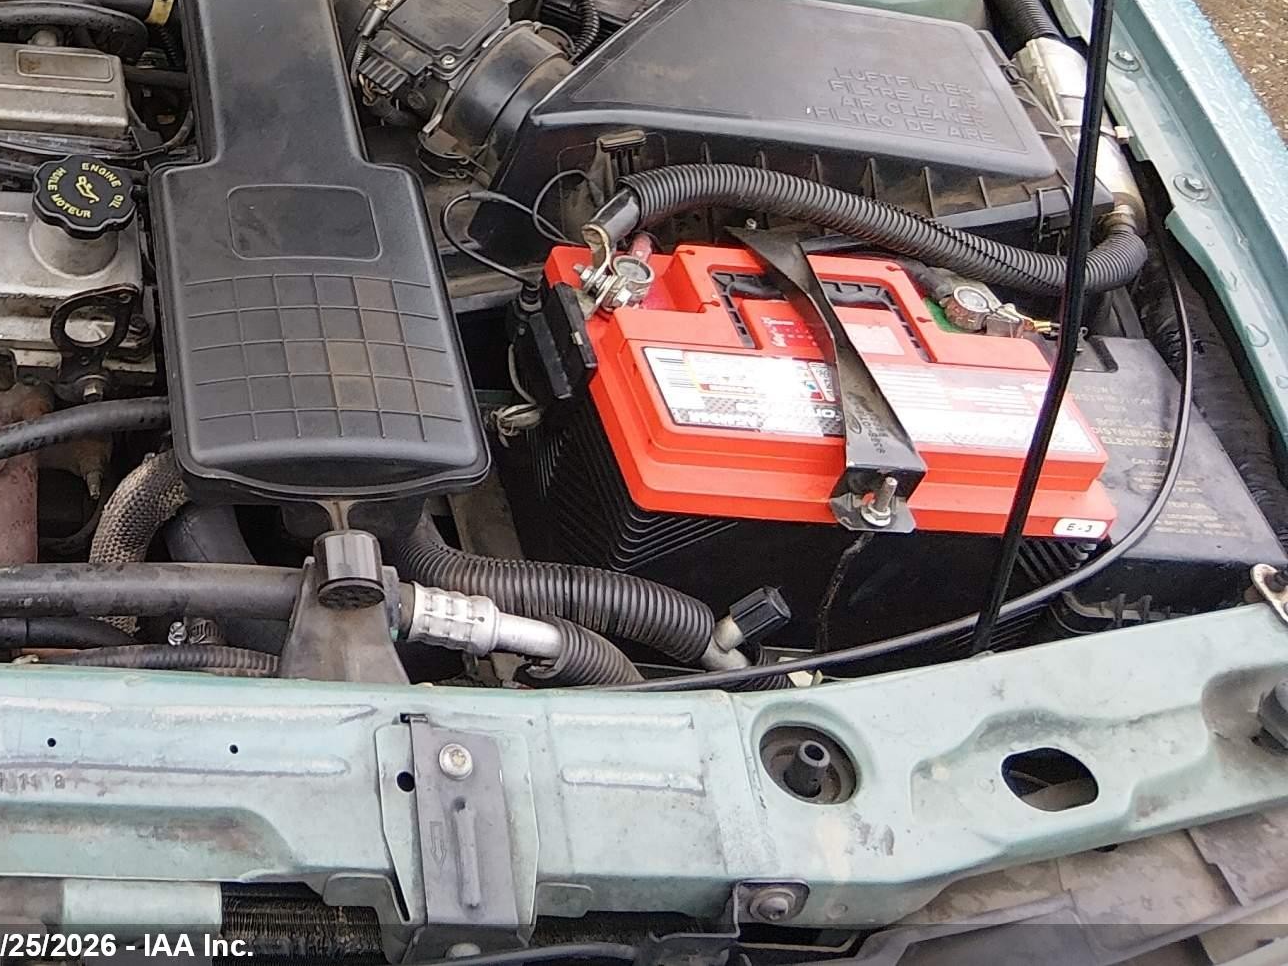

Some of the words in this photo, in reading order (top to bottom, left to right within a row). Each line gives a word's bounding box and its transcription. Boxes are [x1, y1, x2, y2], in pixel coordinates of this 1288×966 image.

[840, 96, 874, 109] AIR
[812, 106, 897, 129] FILTRO
[904, 118, 937, 135] DE
[948, 125, 998, 144] AIRE
[47, 166, 67, 192] HUILE
[80, 162, 123, 188] ENGINE
[108, 194, 125, 209] OIL
[50, 193, 92, 218] MOTEUR
